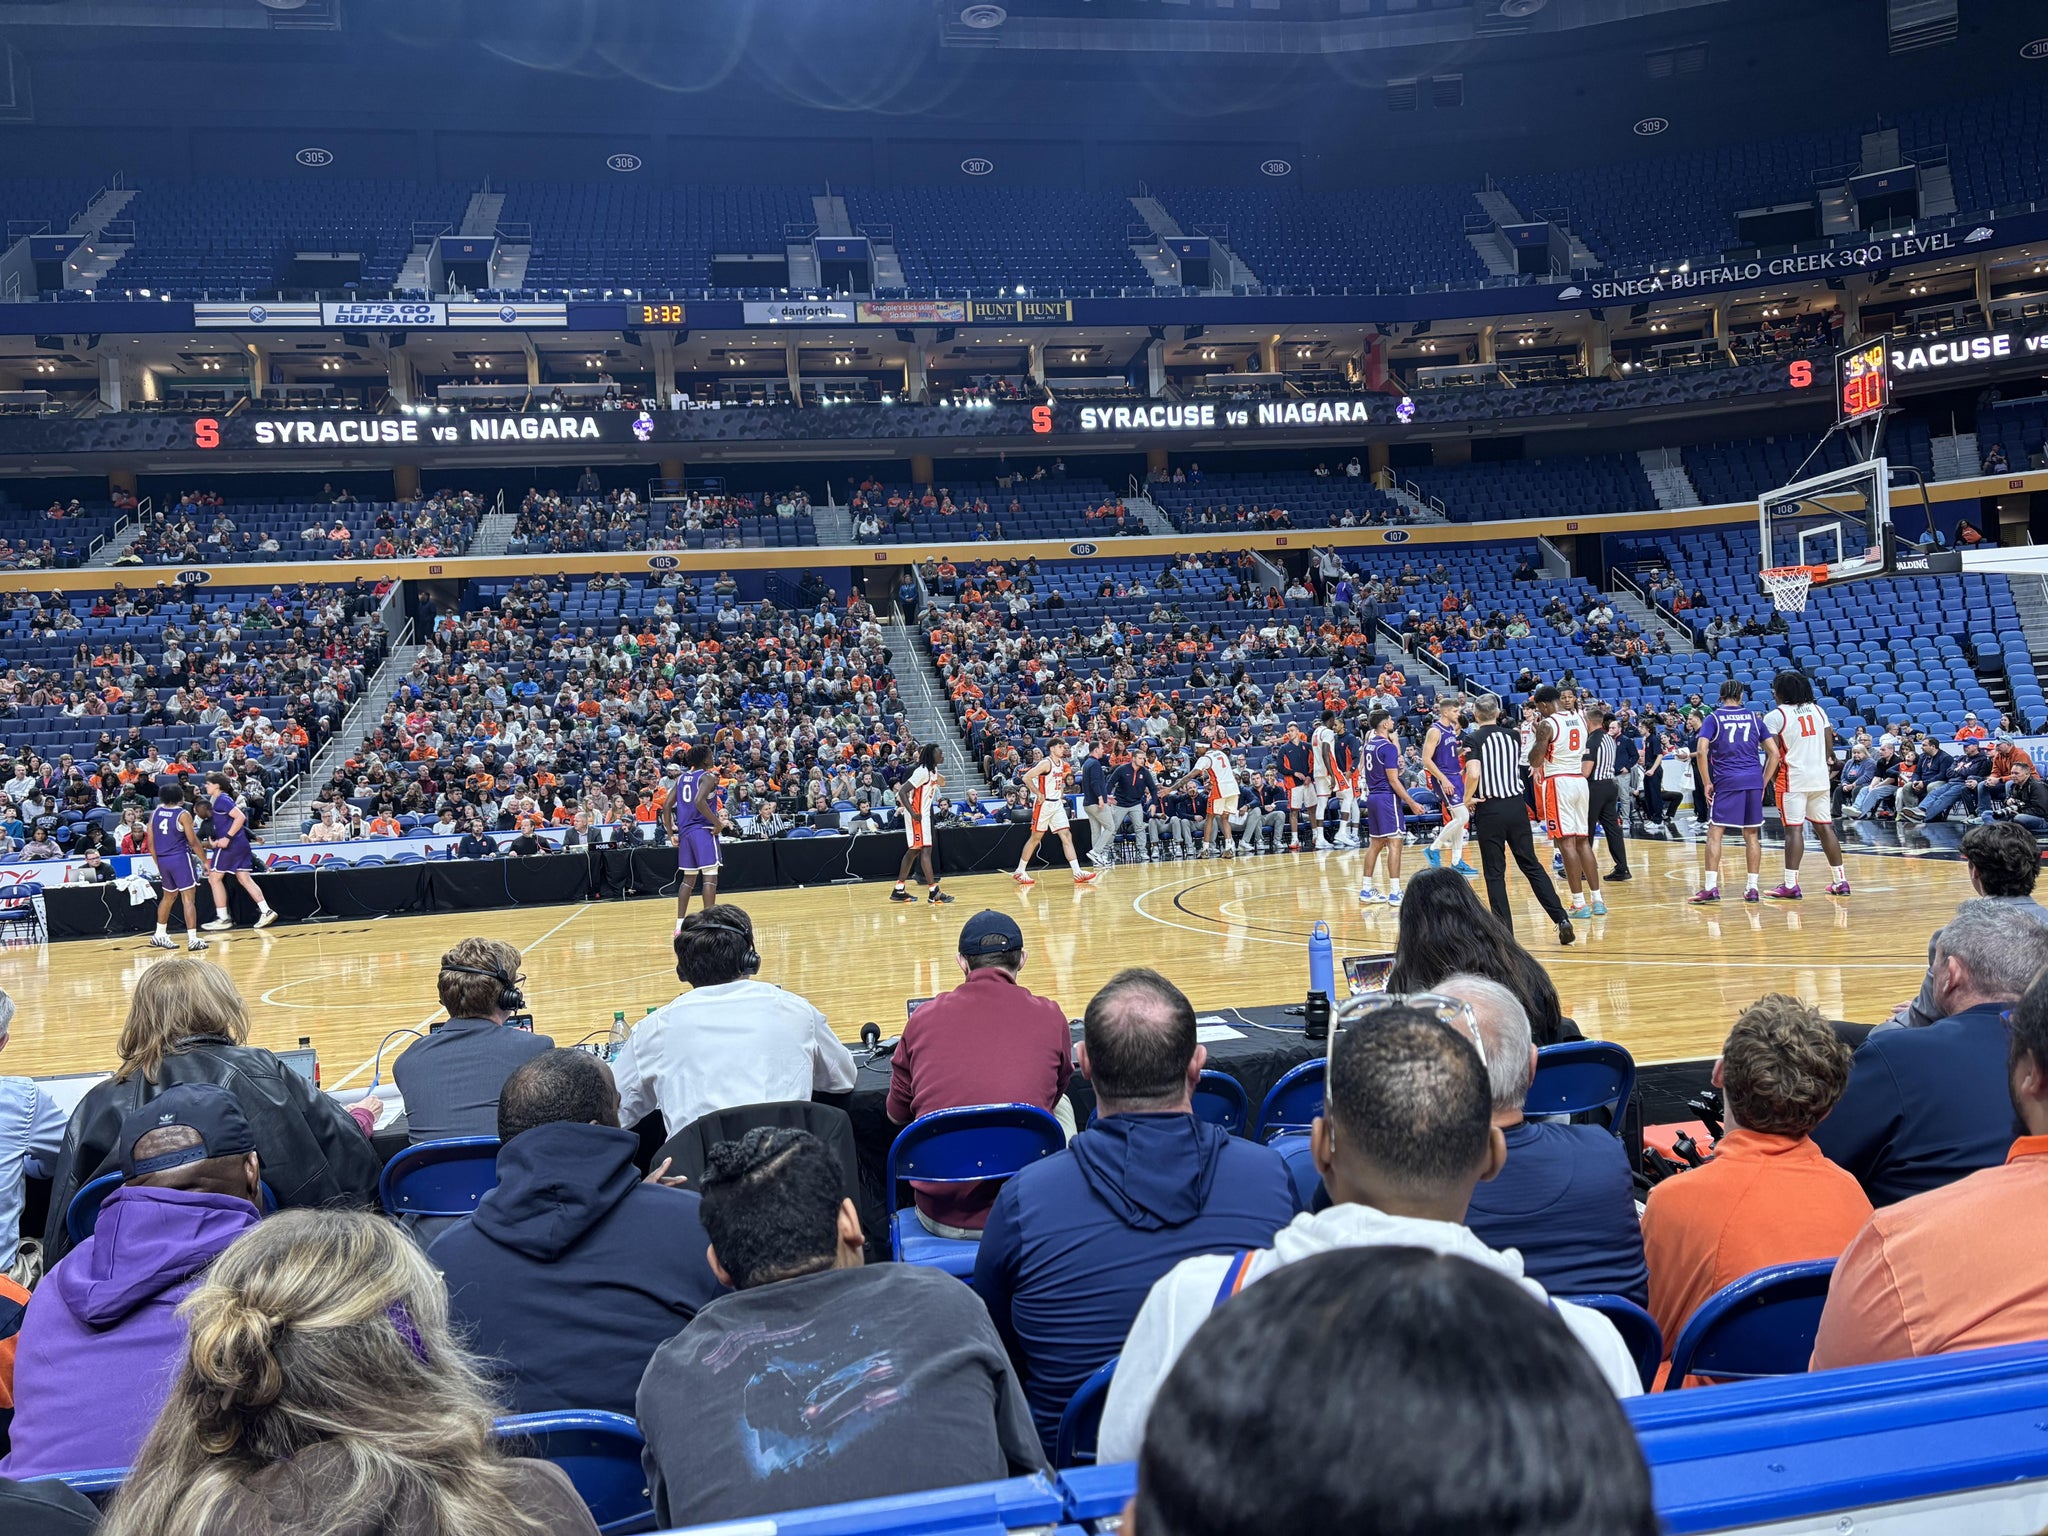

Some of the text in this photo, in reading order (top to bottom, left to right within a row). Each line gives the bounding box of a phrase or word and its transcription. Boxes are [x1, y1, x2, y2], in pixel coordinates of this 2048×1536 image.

[2031, 42, 2048, 55] 310
[1642, 121, 1660, 132] 309
[305, 152, 324, 162] 305
[615, 157, 633, 168] 306
[969, 161, 985, 171] 307
[1268, 163, 1284, 172] 308
[1592, 233, 1955, 299] SENECA BUFFALO CREEK 300 LEVEL
[338, 305, 430, 314] LET'S GO
[643, 305, 682, 322] 3:32
[781, 305, 832, 316] danforth
[975, 303, 1014, 315] HUNT
[1025, 303, 1062, 315] HUNT
[335, 314, 435, 324] BUFFALO!
[1789, 359, 1812, 388] S
[1031, 405, 1052, 432] S
[1081, 405, 1215, 429] SYRACUSE
[1259, 402, 1368, 424] NIAGARA
[195, 418, 220, 448] S
[255, 420, 418, 443] SYRACUSE
[470, 417, 600, 440] NIAGARA
[1777, 504, 1793, 514] 108
[1390, 531, 1402, 541] 107
[1077, 544, 1090, 555] 106
[656, 557, 671, 567] 105
[1896, 558, 1929, 571] PALDING
[185, 572, 202, 583] 104
[1798, 714, 1816, 737] 11
[1723, 722, 1751, 743] 77
[1569, 729, 1580, 751] 8
[1217, 756, 1226, 768] 7
[1366, 753, 1373, 771] 8
[682, 784, 692, 803] 0
[159, 818, 168, 834] 4
[1548, 820, 1556, 830] S
